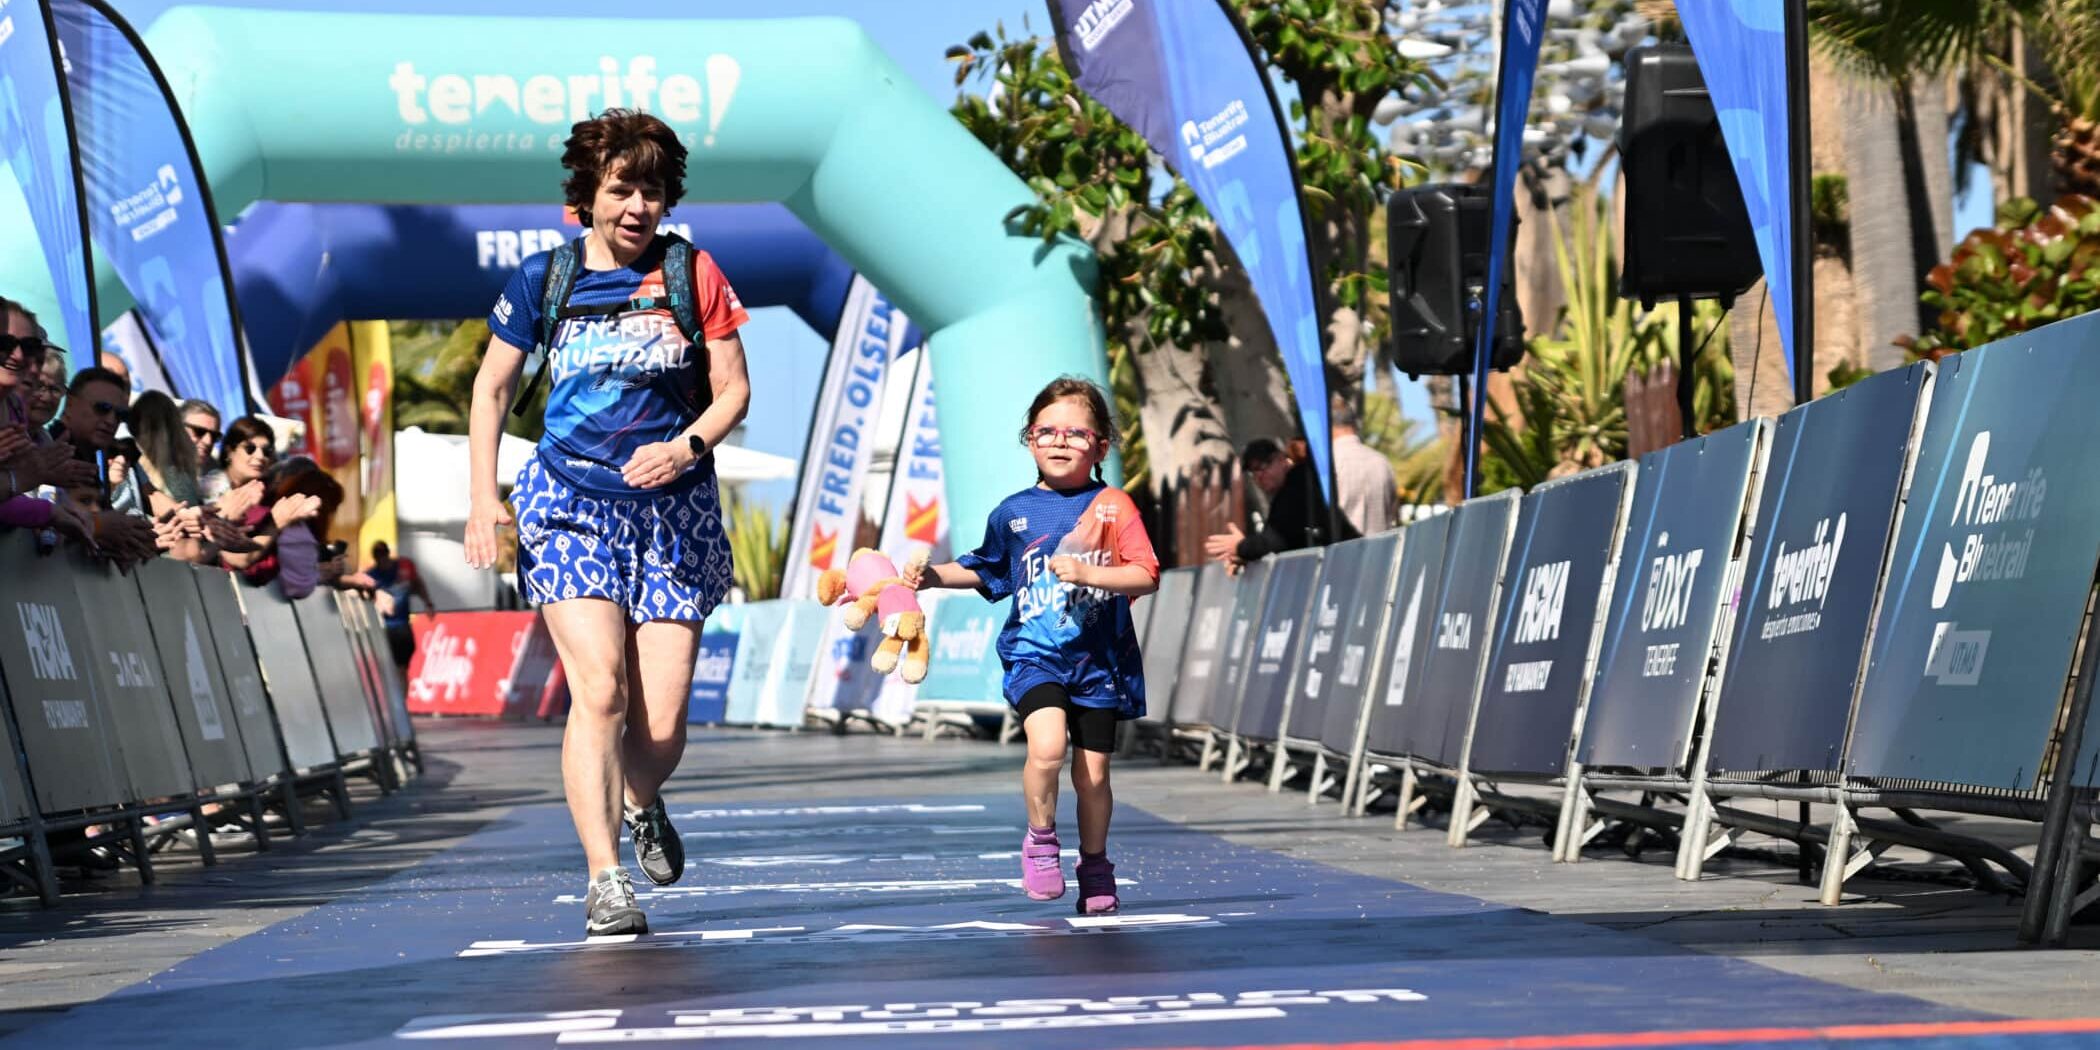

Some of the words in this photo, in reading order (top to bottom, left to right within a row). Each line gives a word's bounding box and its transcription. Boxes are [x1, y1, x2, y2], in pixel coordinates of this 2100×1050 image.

[388, 54, 741, 147] tenerife!
[395, 127, 535, 154] despierta
[547, 339, 693, 386] BLUETRAIL
[1975, 466, 2048, 526] Tenerife
[1767, 511, 1848, 628] tenerife!
[1956, 529, 2036, 583] Bluetrail
[1513, 560, 1572, 644] HOKA
